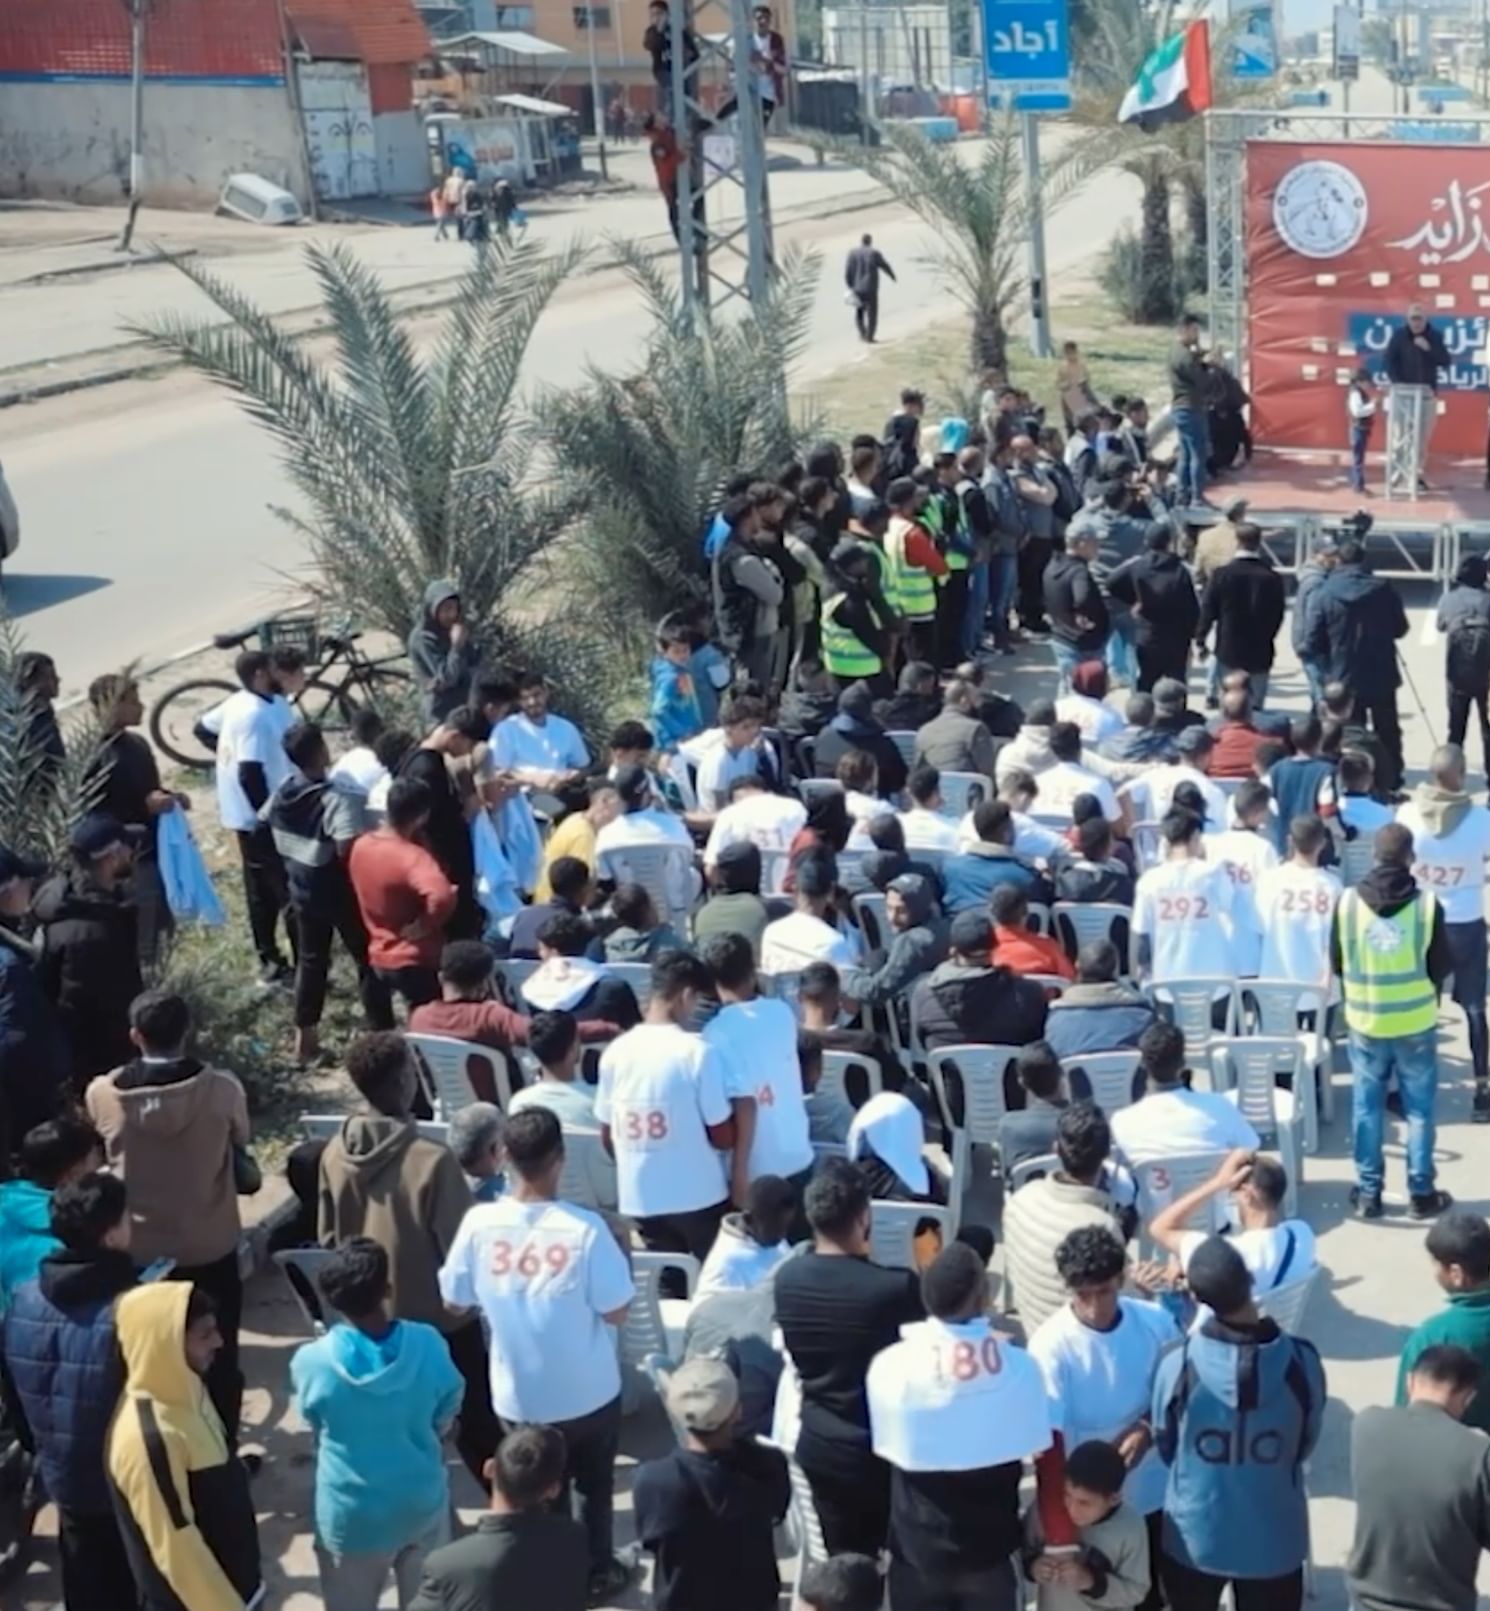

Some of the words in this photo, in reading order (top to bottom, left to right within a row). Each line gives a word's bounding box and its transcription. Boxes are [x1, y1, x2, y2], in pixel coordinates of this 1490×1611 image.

[1160, 897, 1209, 920] 292
[1282, 889, 1330, 914] 258
[491, 1240, 570, 1278] 369
[1194, 1420, 1284, 1466] alo
